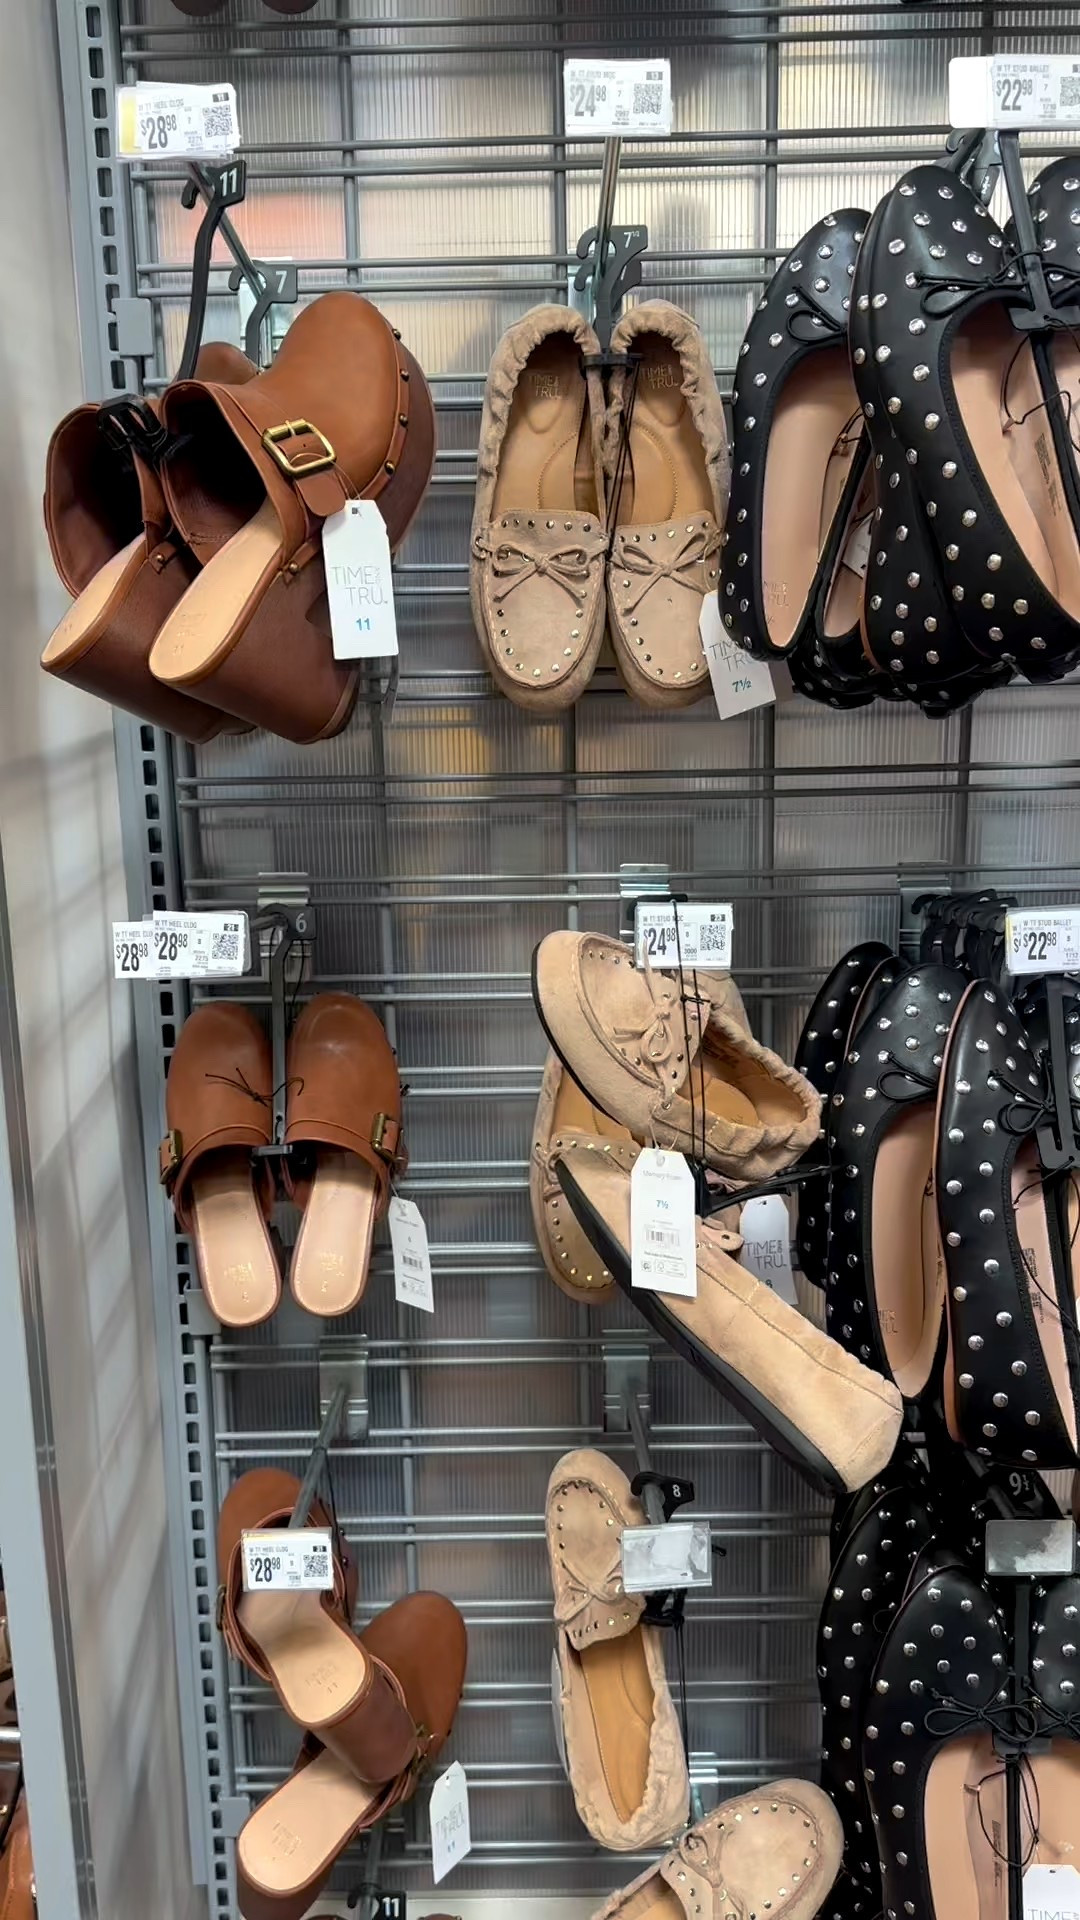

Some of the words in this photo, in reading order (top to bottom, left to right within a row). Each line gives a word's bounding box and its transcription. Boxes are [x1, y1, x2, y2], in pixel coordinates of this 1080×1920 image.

[220, 168, 238, 197] 11
[275, 271, 288, 294] 7
[331, 566, 375, 585] TIME
[356, 618, 370, 631] 11
[296, 913, 307, 933] 6
[745, 1240, 777, 1257] TIME
[672, 1484, 681, 1498] 8
[382, 1896, 400, 1917] 11
